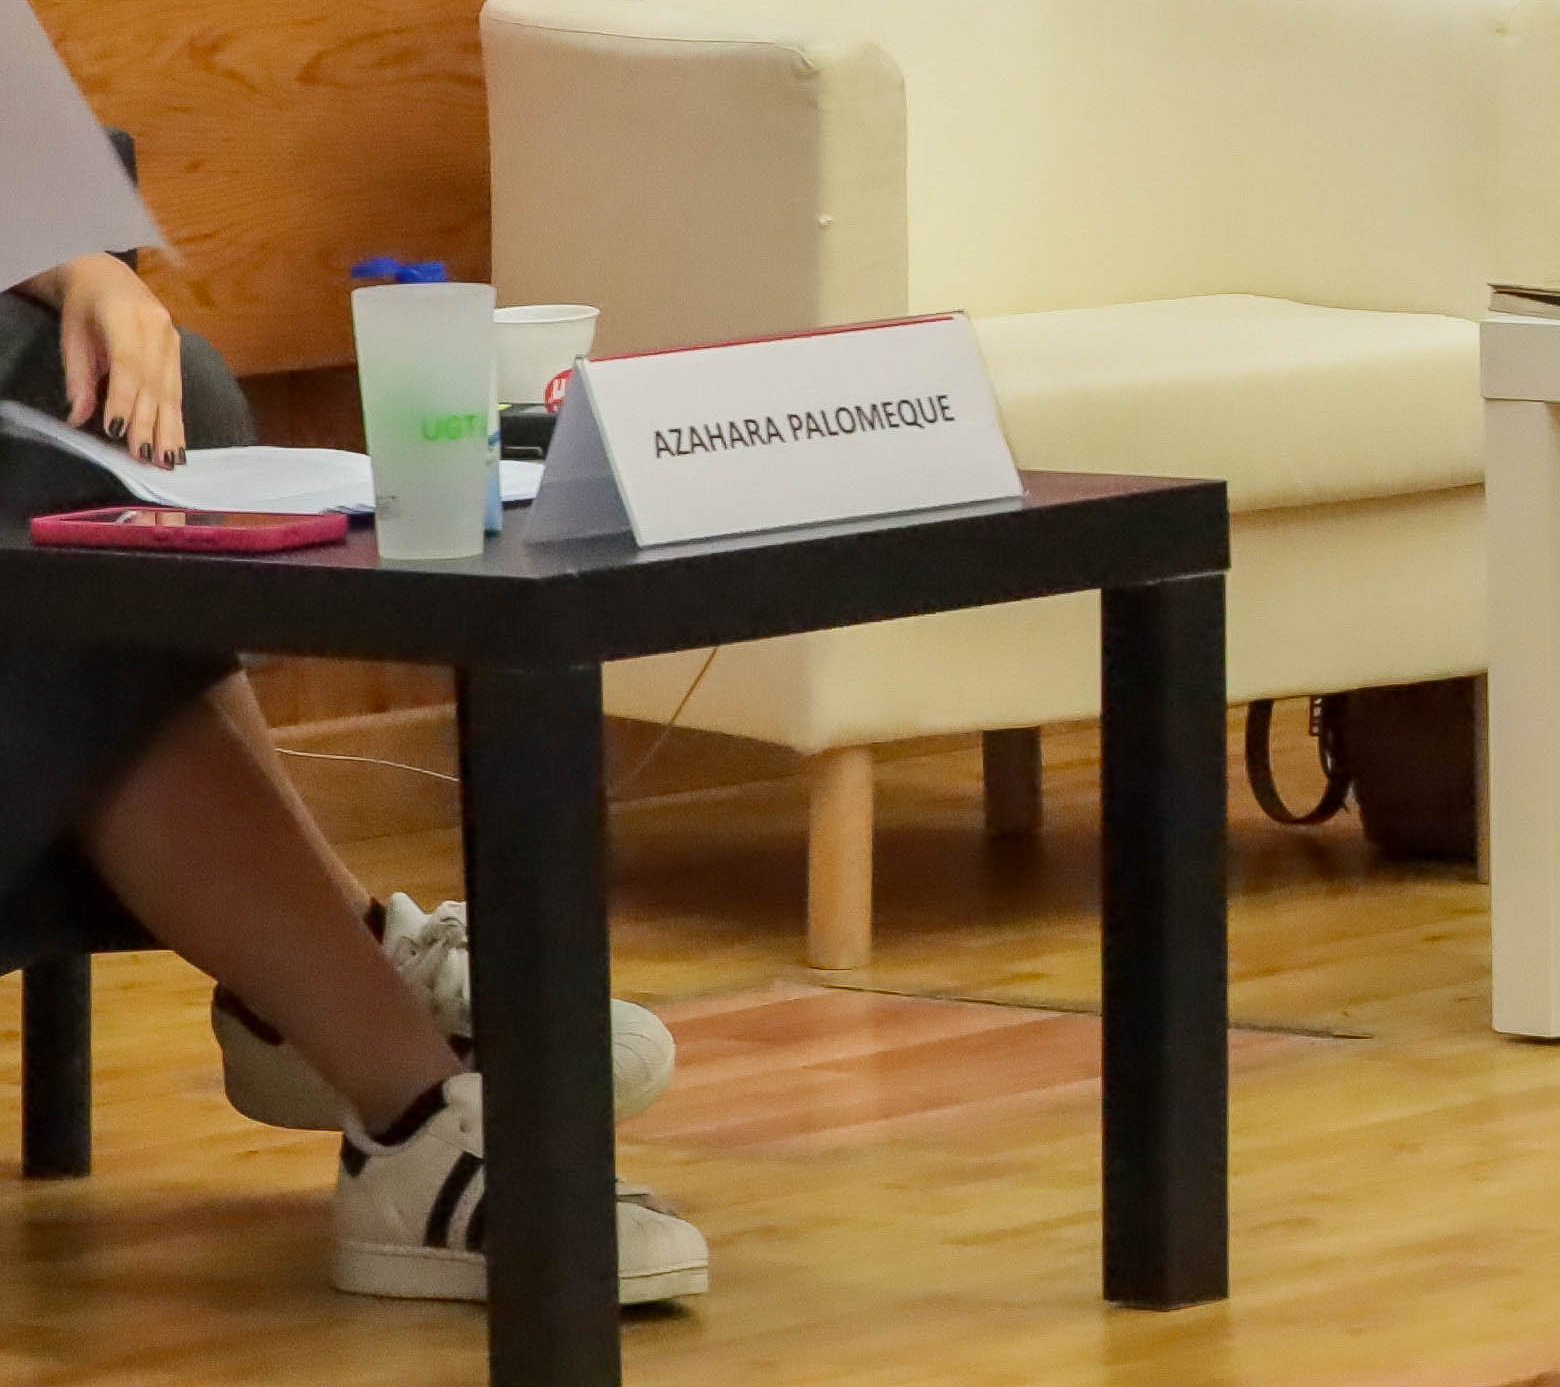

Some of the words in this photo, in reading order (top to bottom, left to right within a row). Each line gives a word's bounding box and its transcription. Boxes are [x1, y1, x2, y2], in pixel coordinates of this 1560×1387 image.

[421, 413, 478, 441] UGT
[653, 415, 787, 459] AZAHARA
[786, 393, 956, 443] PALOMEQUE
